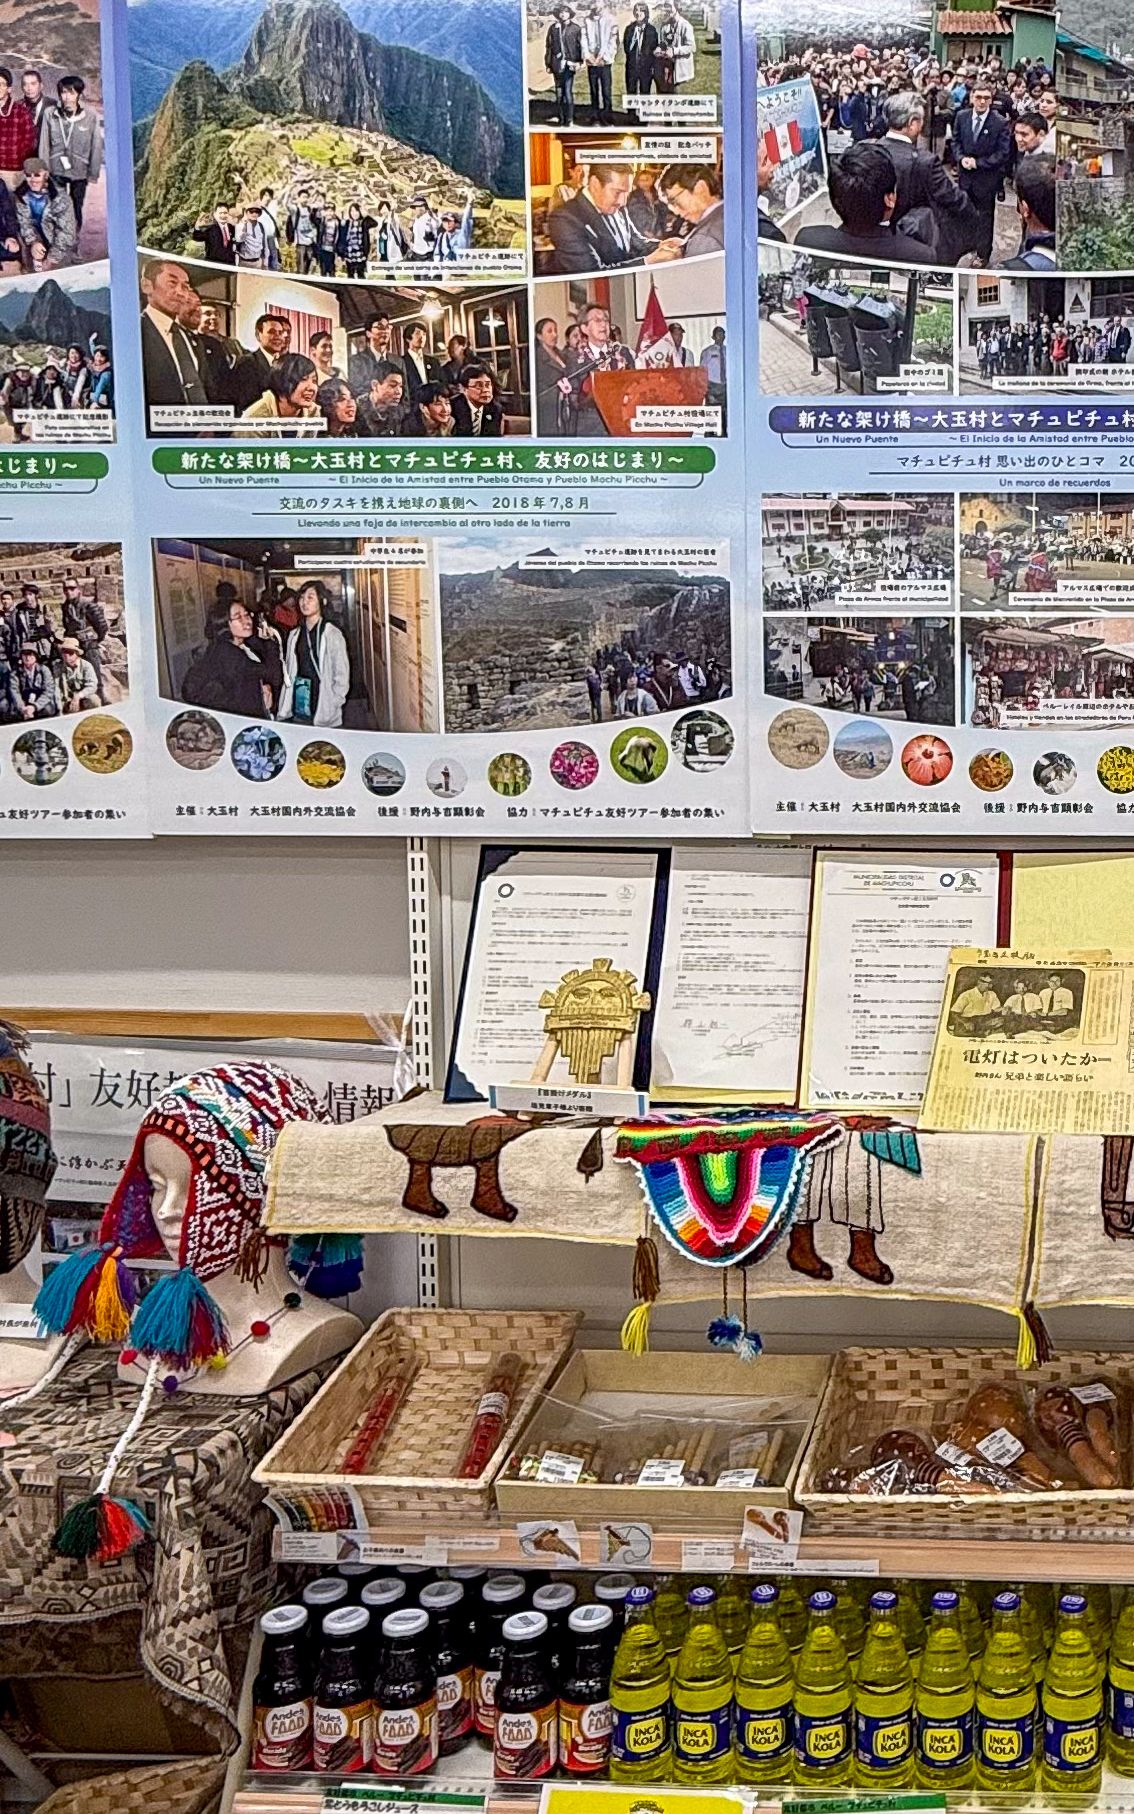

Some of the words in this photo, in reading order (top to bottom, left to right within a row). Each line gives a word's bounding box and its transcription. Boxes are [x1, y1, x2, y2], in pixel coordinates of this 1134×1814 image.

[816, 435, 828, 443] Un
[832, 435, 861, 443] Nuevo
[865, 435, 899, 443] Puente
[973, 435, 1000, 443] Inicio
[1029, 435, 1069, 443] Amistad
[1072, 435, 1097, 443] entre
[1101, 435, 1133, 443] Pueblo
[896, 455, 991, 467] マチュピチュ村
[997, 455, 1105, 467] 思い出のひとコマ
[199, 476, 213, 485] Un
[215, 476, 243, 485] Nuevo
[246, 476, 280, 485] Puente
[352, 476, 380, 485] Inicio
[406, 476, 445, 485] Amistad
[449, 476, 474, 485] entre
[477, 476, 509, 485] Pueblo
[512, 476, 544, 485] Otama
[555, 475, 588, 484] Pueblo
[591, 475, 622, 484] Machu
[625, 475, 657, 484] Picchu
[1000, 478, 1013, 487] Un
[1016, 479, 1045, 487] marco
[1048, 479, 1060, 487] de
[1063, 479, 1111, 487] recuerdos
[279, 496, 479, 510] 交流のタスキを携え地球の裏側へ
[297, 519, 340, 528] Llevando
[401, 519, 457, 528] intercambio
[543, 519, 571, 528] tierra
[250, 807, 356, 818] 大玉村国内外交流協会
[852, 802, 961, 813] 大玉村国内外交流協会
[28, 1060, 180, 1112] 村」友好
[271, 1708, 305, 1723] Andes
[316, 1712, 341, 1724] Andes
[383, 1715, 416, 1727] Andes
[502, 1718, 532, 1731] Andes
[634, 1725, 660, 1737] INCA
[683, 1728, 707, 1738] INCA
[753, 1725, 778, 1736] INCA
[633, 1735, 663, 1747] KOLA
[682, 1737, 710, 1747] KOLA
[752, 1734, 780, 1745] KOLA
[815, 1731, 840, 1742] INCA
[882, 1731, 907, 1743] INCA
[930, 1735, 955, 1744] INCA
[989, 1734, 1014, 1744] INCA
[1070, 1736, 1095, 1747] INCA
[813, 1741, 841, 1752] KOLA
[880, 1739, 907, 1752] KOLA
[929, 1742, 956, 1753] KOLA
[988, 1743, 1015, 1755] KOLA
[1068, 1744, 1095, 1755] KOLA
